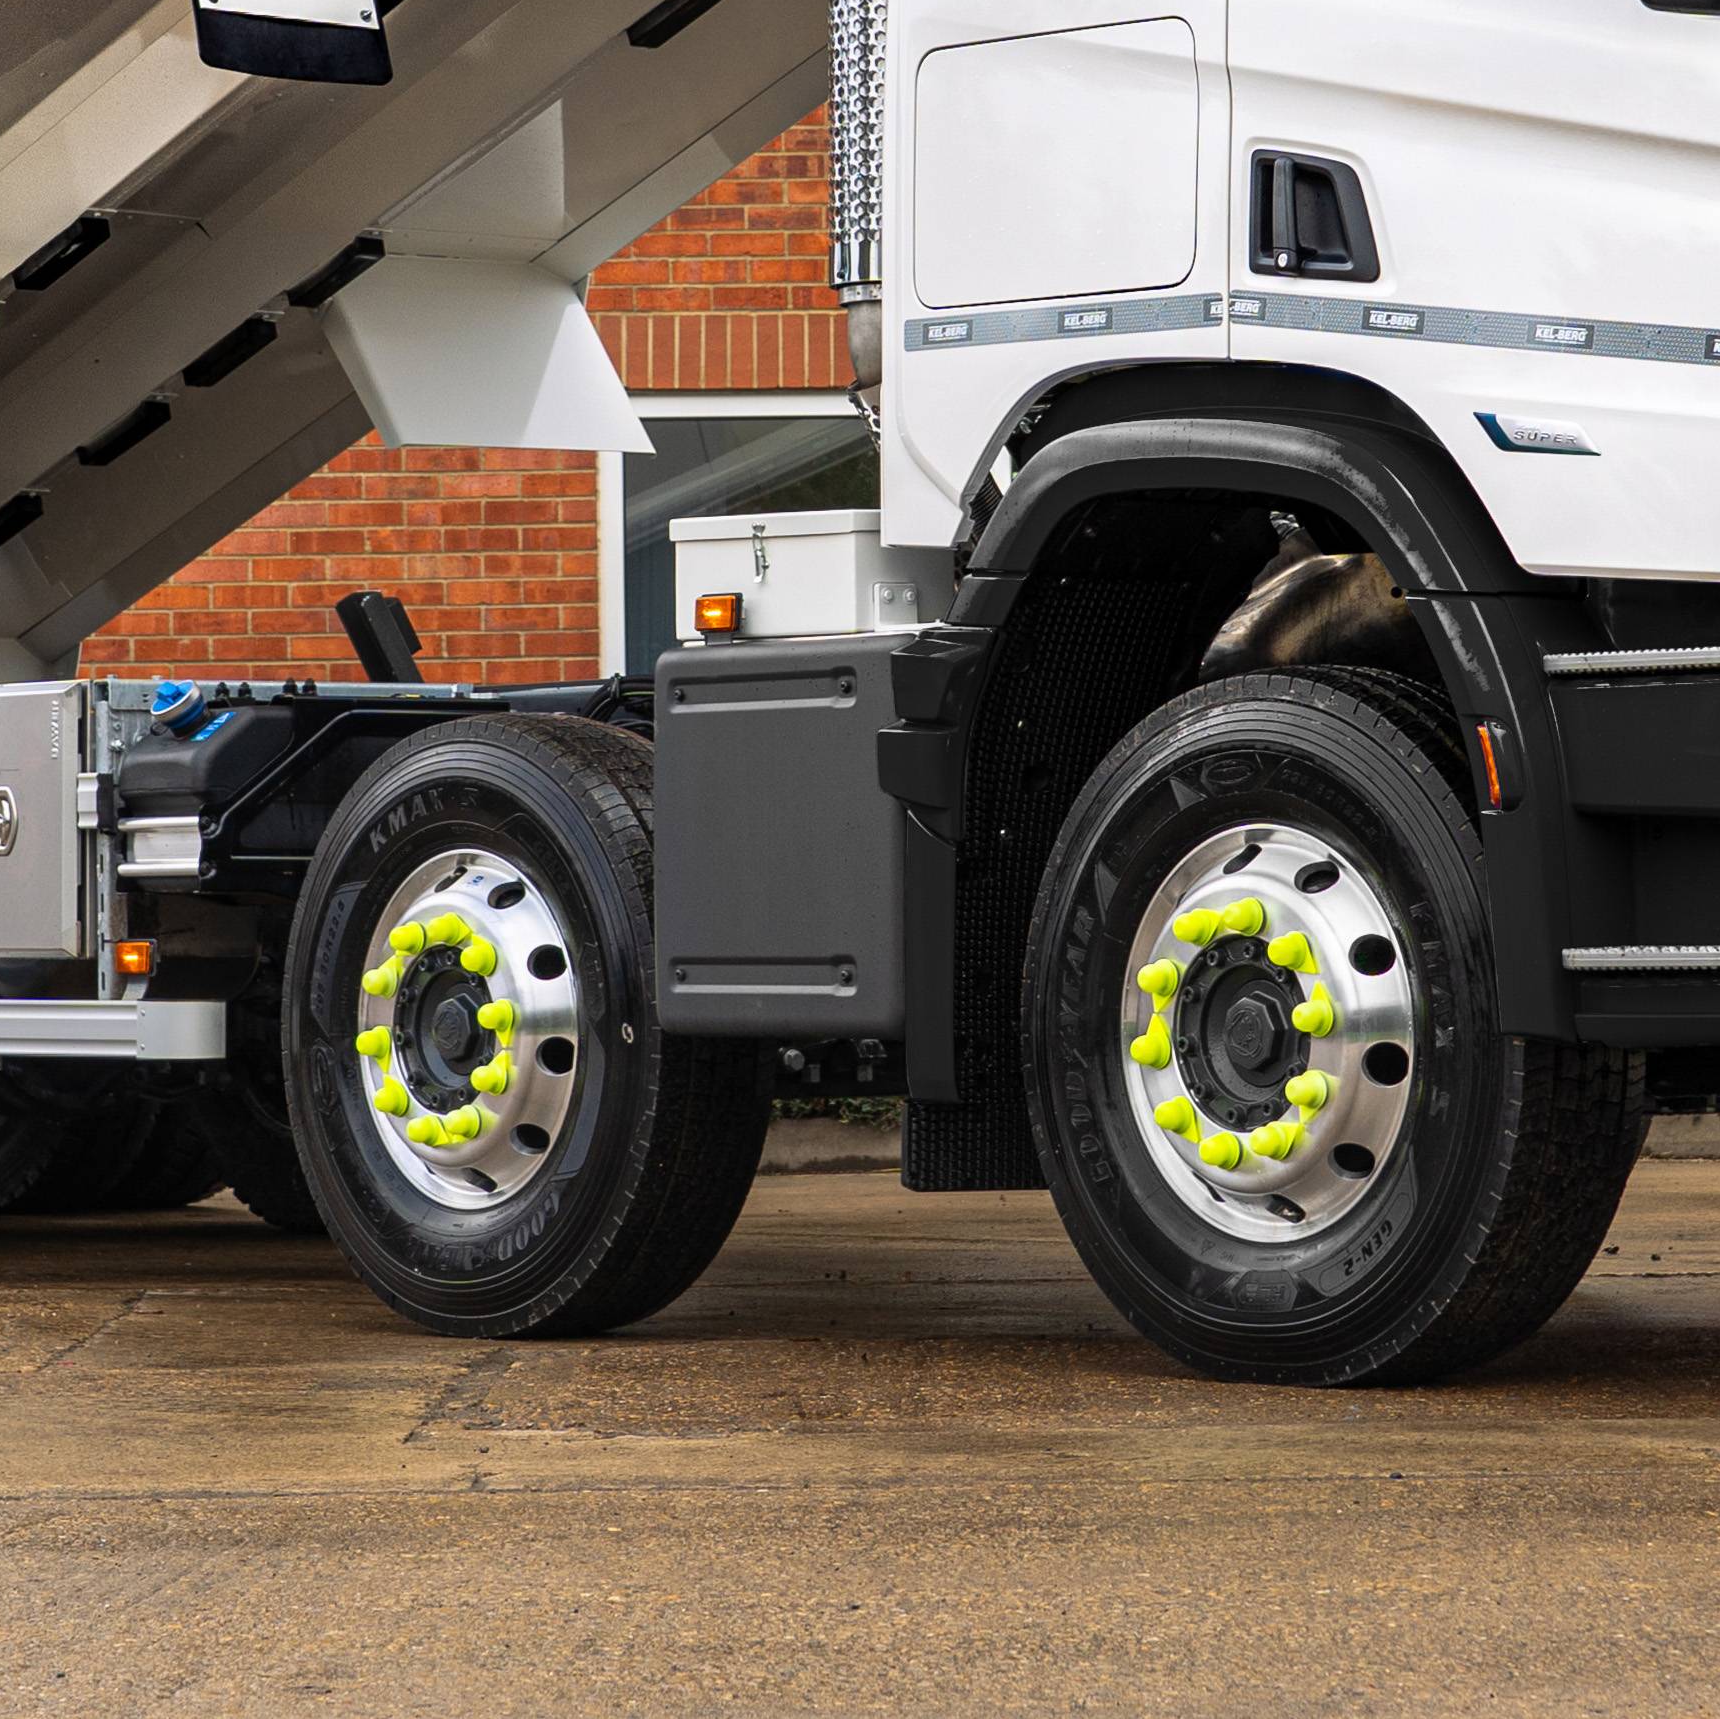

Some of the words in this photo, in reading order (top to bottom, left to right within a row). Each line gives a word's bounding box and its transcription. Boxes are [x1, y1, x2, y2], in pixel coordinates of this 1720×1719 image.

[1064, 312, 1108, 327] KEL-BERG
[1369, 312, 1419, 328] KEL-BERG
[928, 324, 968, 339] KEL-BERG
[1535, 326, 1588, 342] KEL-BERG
[1513, 430, 1578, 446] SUPER
[1059, 905, 1116, 1184] GOODYEAR
[1343, 1219, 1394, 1278] GEN-2
